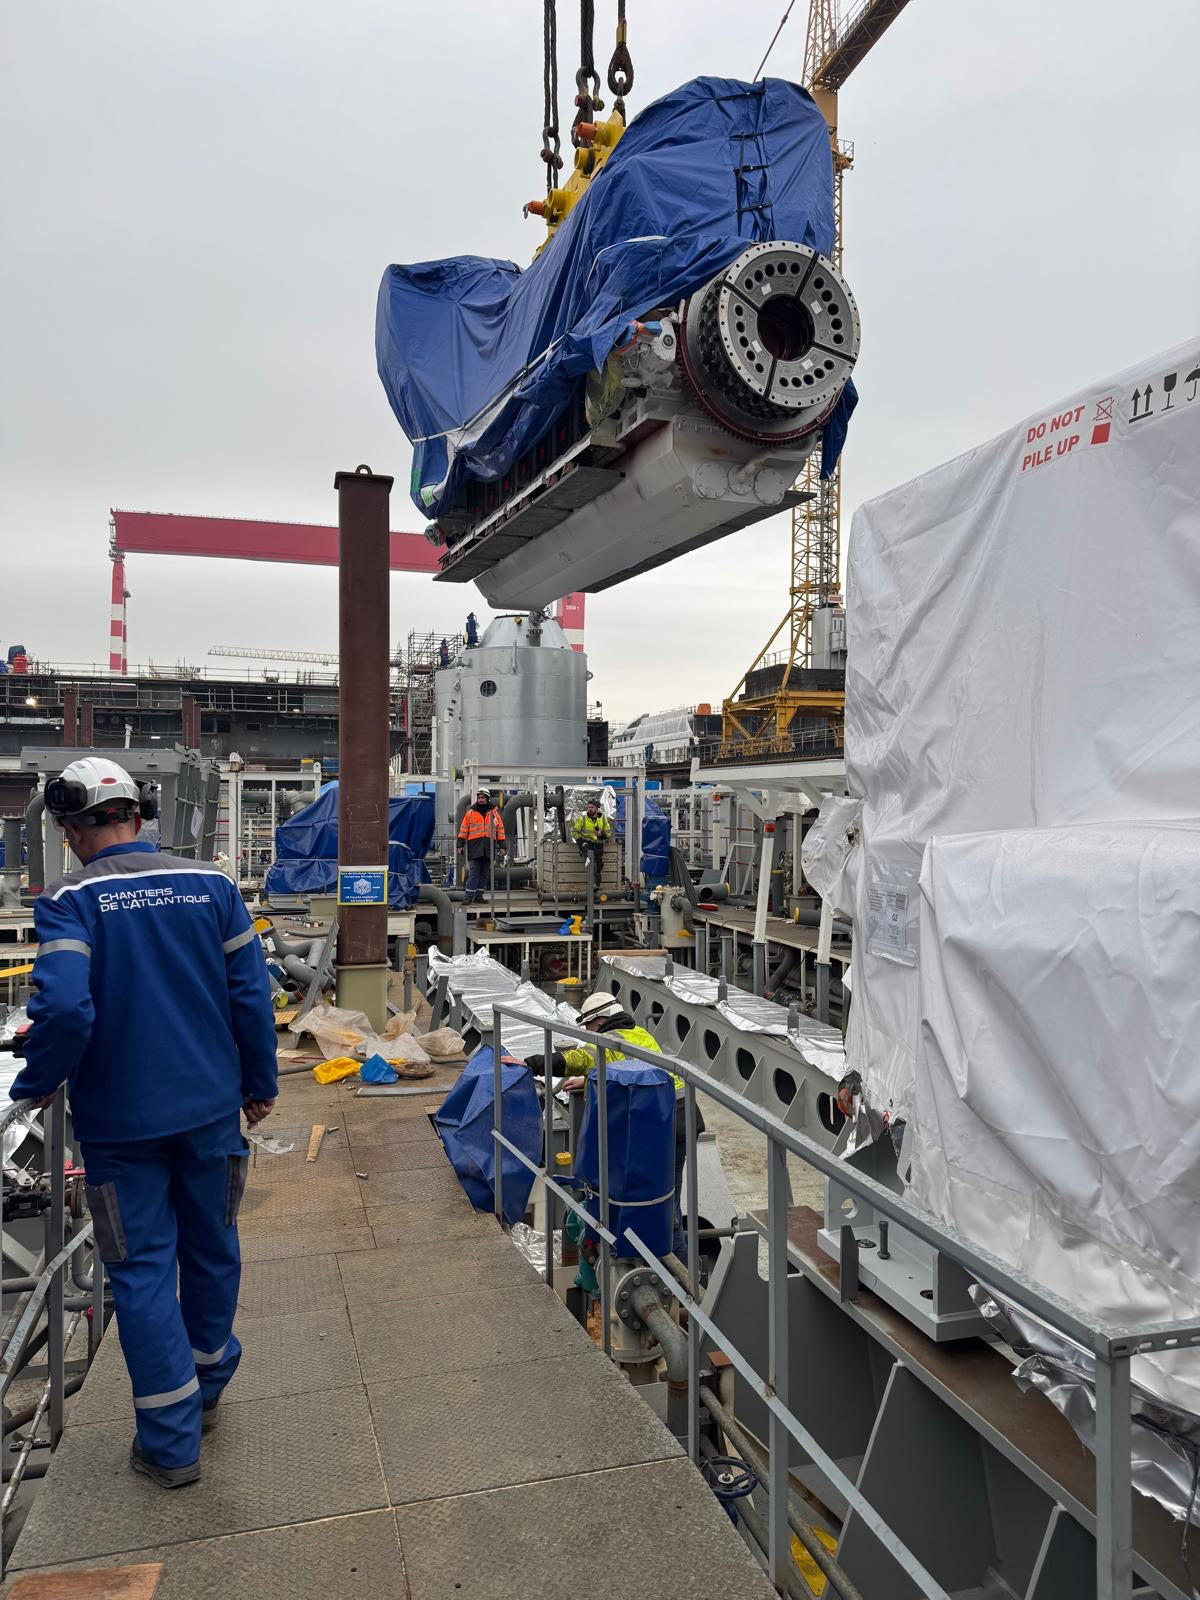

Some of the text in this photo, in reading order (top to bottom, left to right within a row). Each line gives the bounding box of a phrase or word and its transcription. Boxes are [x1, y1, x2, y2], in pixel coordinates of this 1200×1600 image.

[1027, 405, 1085, 443] DO NOT
[1022, 434, 1080, 471] PILE UP
[98, 887, 173, 903] CHANTIERS
[100, 895, 210, 912] DE L'ATLANTIQUE
